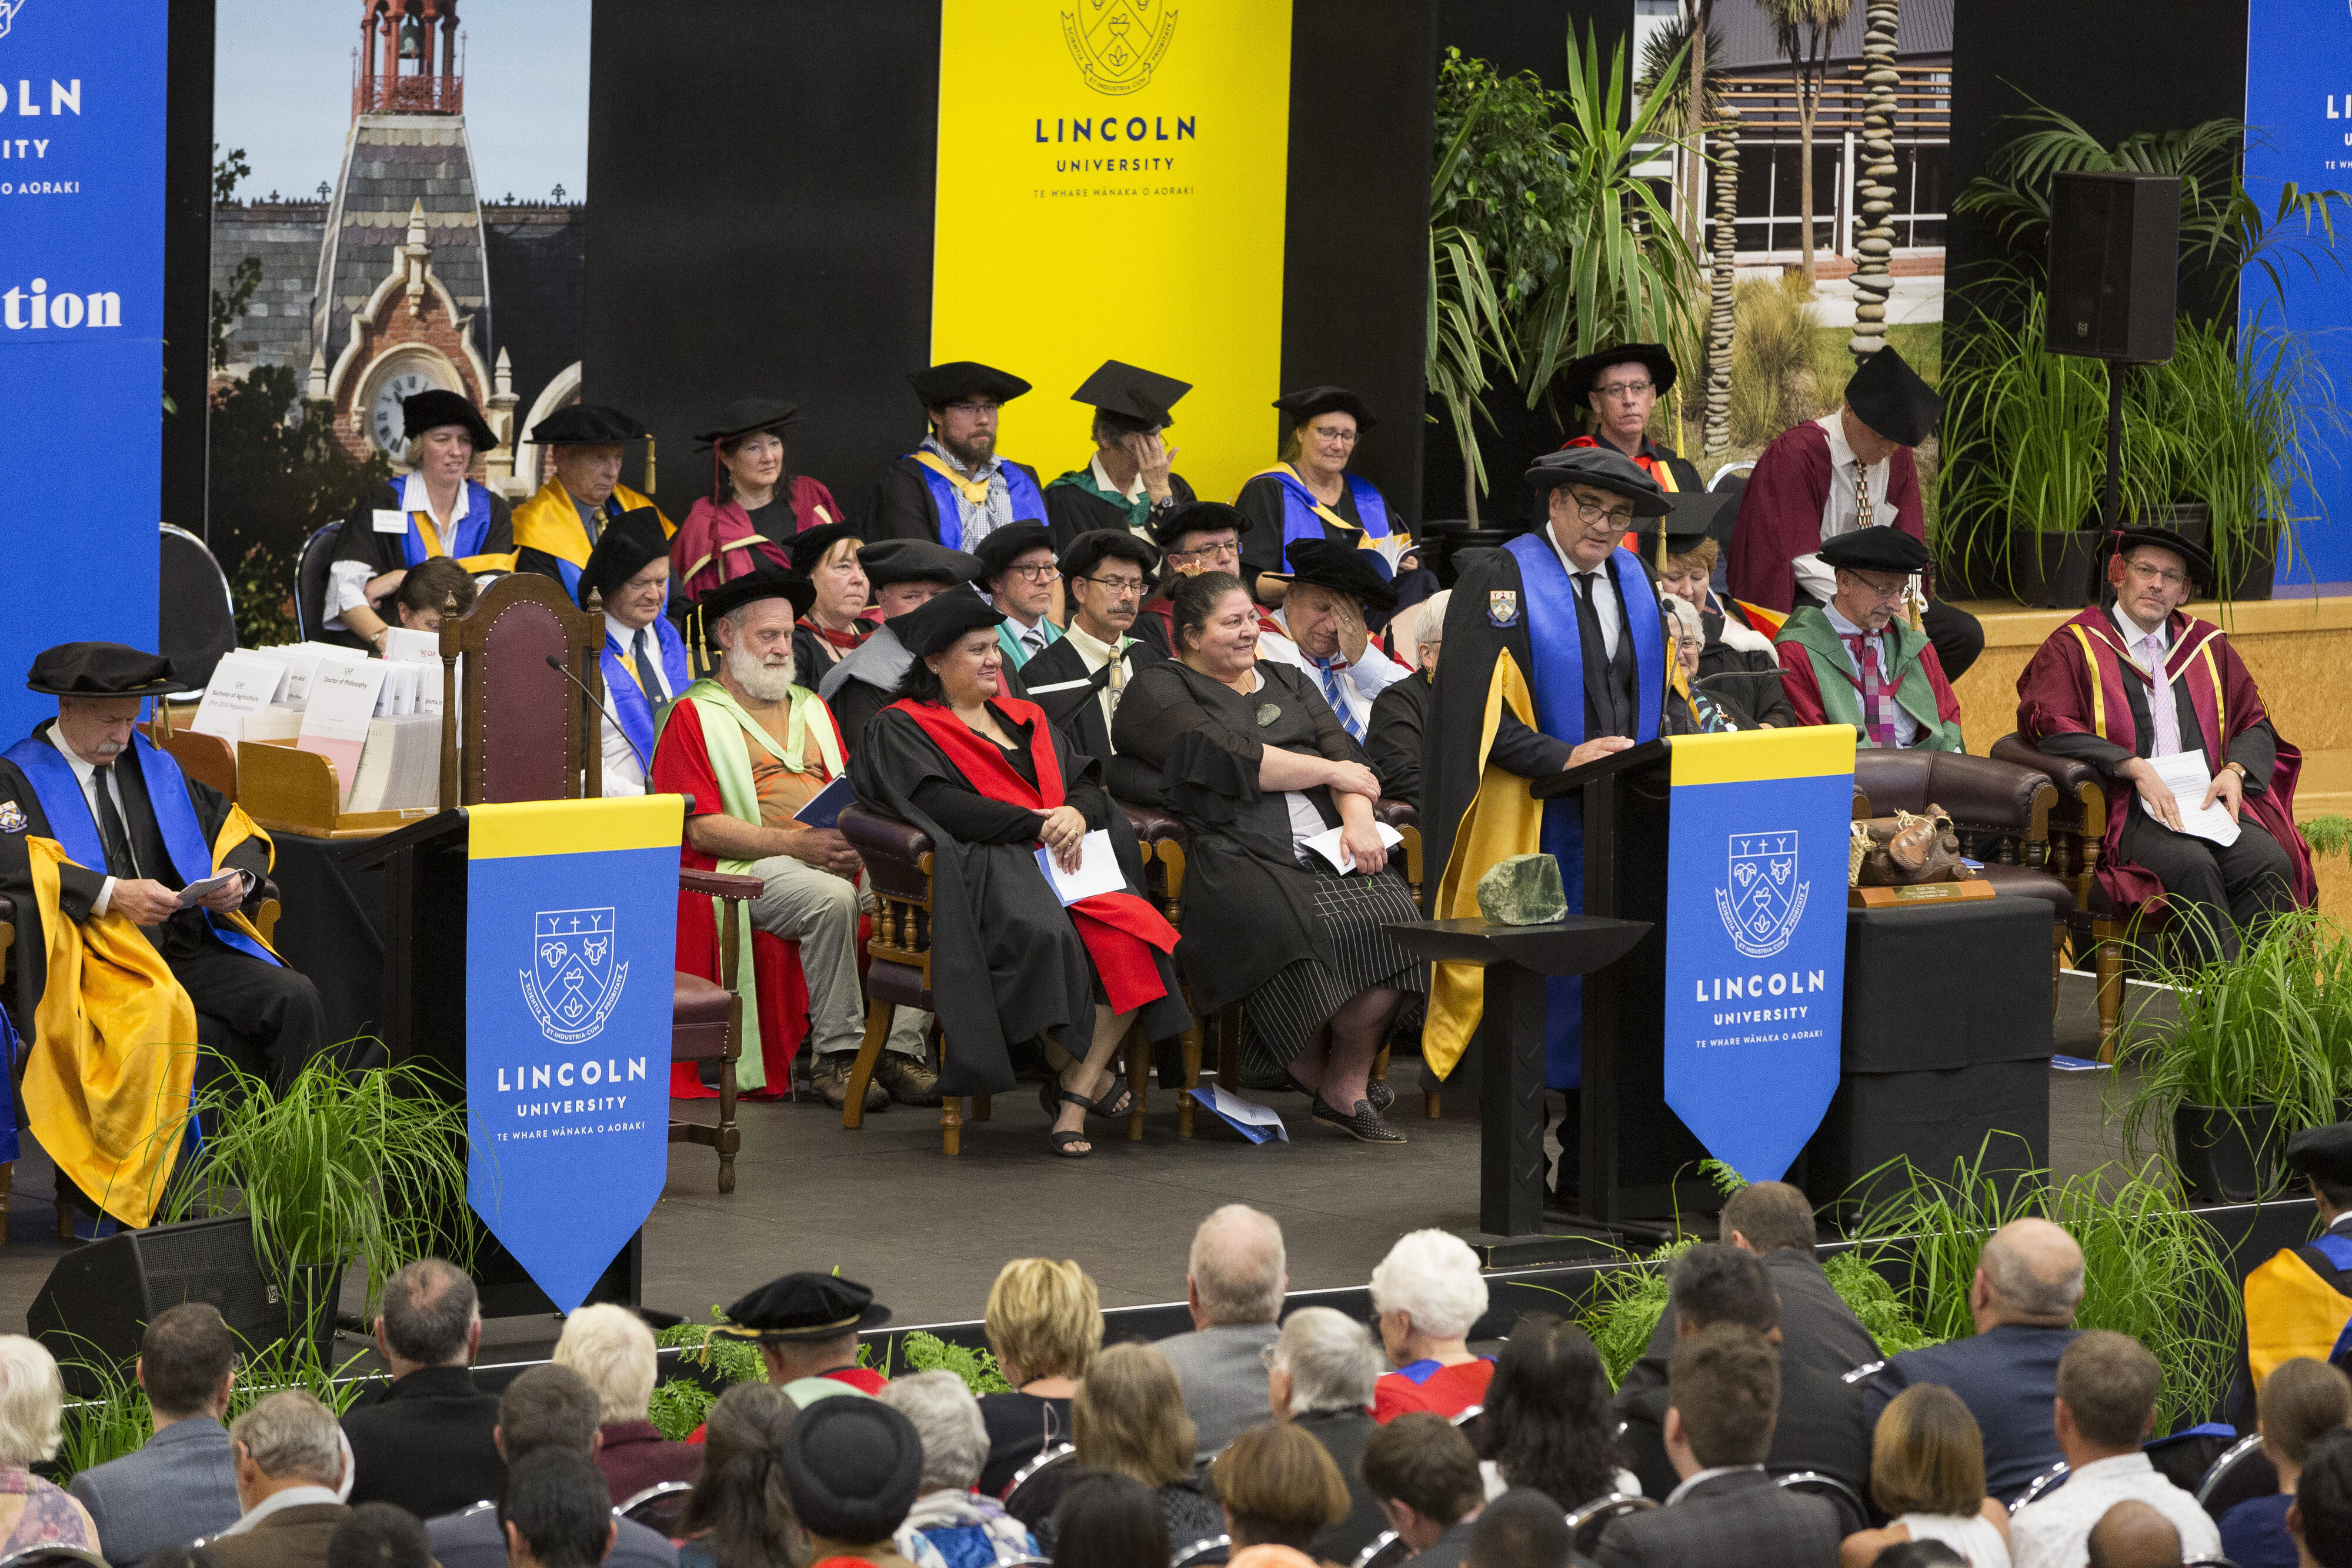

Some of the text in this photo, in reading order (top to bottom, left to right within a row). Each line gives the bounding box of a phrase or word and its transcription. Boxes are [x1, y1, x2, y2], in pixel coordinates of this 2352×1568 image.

[0, 79, 81, 115] LN
[1036, 116, 1195, 143] LINCOLN
[3, 139, 49, 159] ITY
[1057, 158, 1174, 172] UNIVERSITY
[2325, 160, 2336, 169] TE
[1, 181, 79, 195] O AORAKI
[1033, 189, 1045, 198] TE
[1051, 188, 1088, 198] WHARE
[1093, 186, 1137, 196] WĀNAKA
[1154, 186, 1195, 195] AORAKI
[2, 278, 122, 330] tion
[344, 680, 368, 689] Philosophy
[236, 693, 259, 702] Agriculture
[1720, 900, 1735, 931] SCIENTIA
[1789, 893, 1805, 927] PROBITATE
[604, 973, 623, 1011] PROBITATE
[1697, 970, 1824, 1002] LINCOLN
[525, 983, 542, 1016] SCIENTIA
[1714, 1006, 1808, 1026] UNIVERSITY
[1696, 1030, 1823, 1049] TE WHARE WĀNAKA O AORAKI
[498, 1056, 646, 1092] LINCOLN
[517, 1096, 626, 1117] UNIVERSITY
[497, 1121, 645, 1142] TE WHARE WĀNAKA O AORAKI
